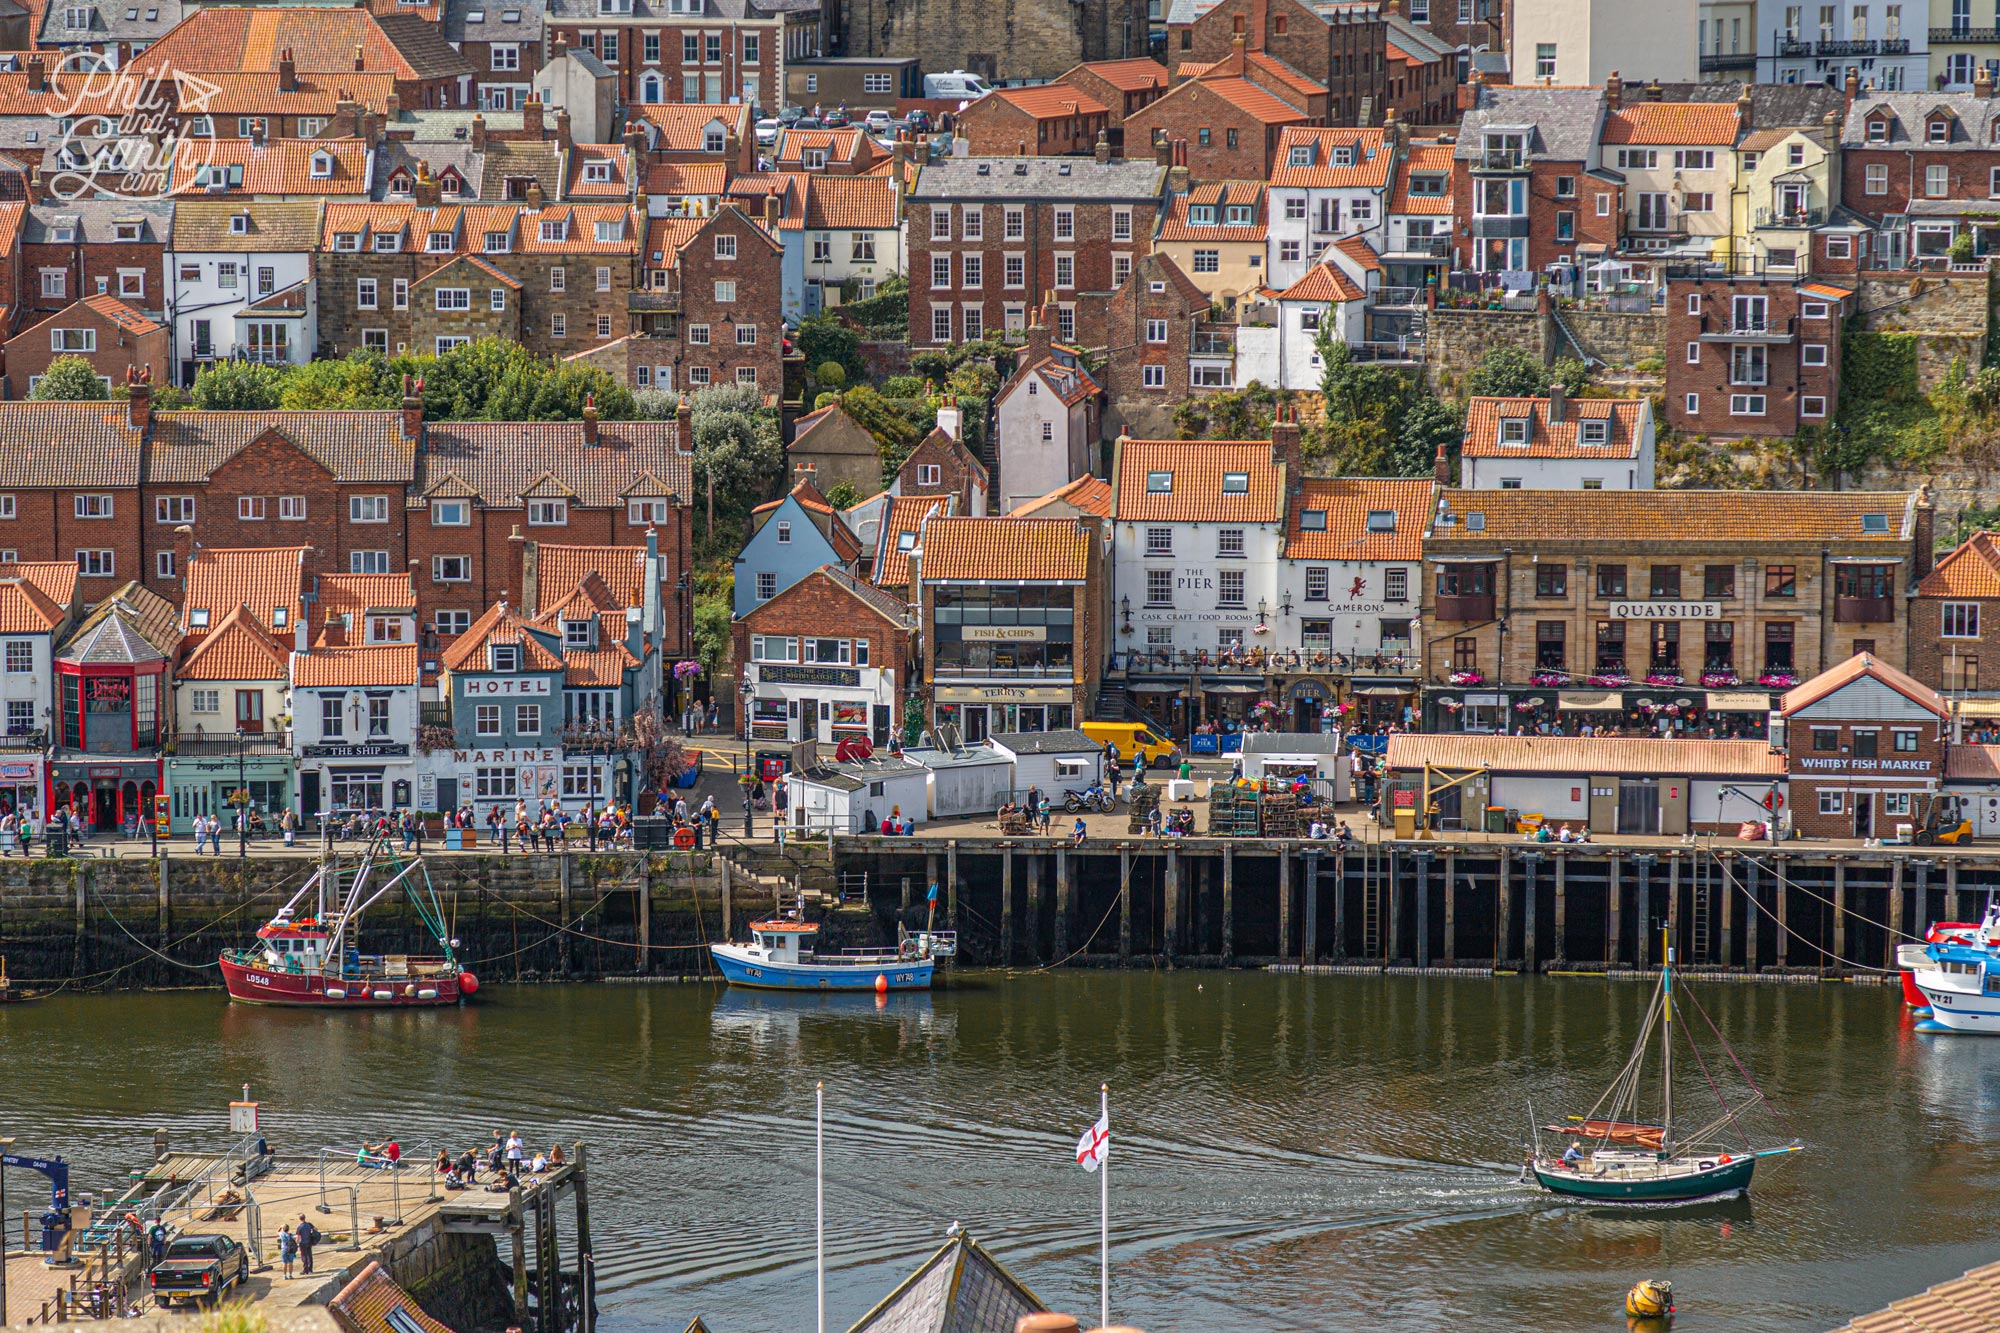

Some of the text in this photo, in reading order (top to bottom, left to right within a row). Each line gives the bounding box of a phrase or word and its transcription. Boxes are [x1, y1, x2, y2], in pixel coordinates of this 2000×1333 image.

[1185, 568, 1204, 576] THE
[1178, 577, 1213, 589] PIER
[1328, 603, 1385, 612] CAMERONS
[1617, 604, 1714, 618] QUAYSIDE
[974, 628, 1035, 638] FISH & CHIPS
[468, 681, 547, 693] HOTEL
[982, 688, 1026, 698] TERRY'S
[1296, 689, 1320, 697] PIER
[330, 746, 381, 756] THE SHIP
[454, 749, 554, 763] MARINE
[196, 763, 225, 772] Proper
[1801, 758, 1932, 770] WHITBY FISH MARKET
[1989, 810, 1997, 823] 3
[1943, 995, 1952, 1004] 21
